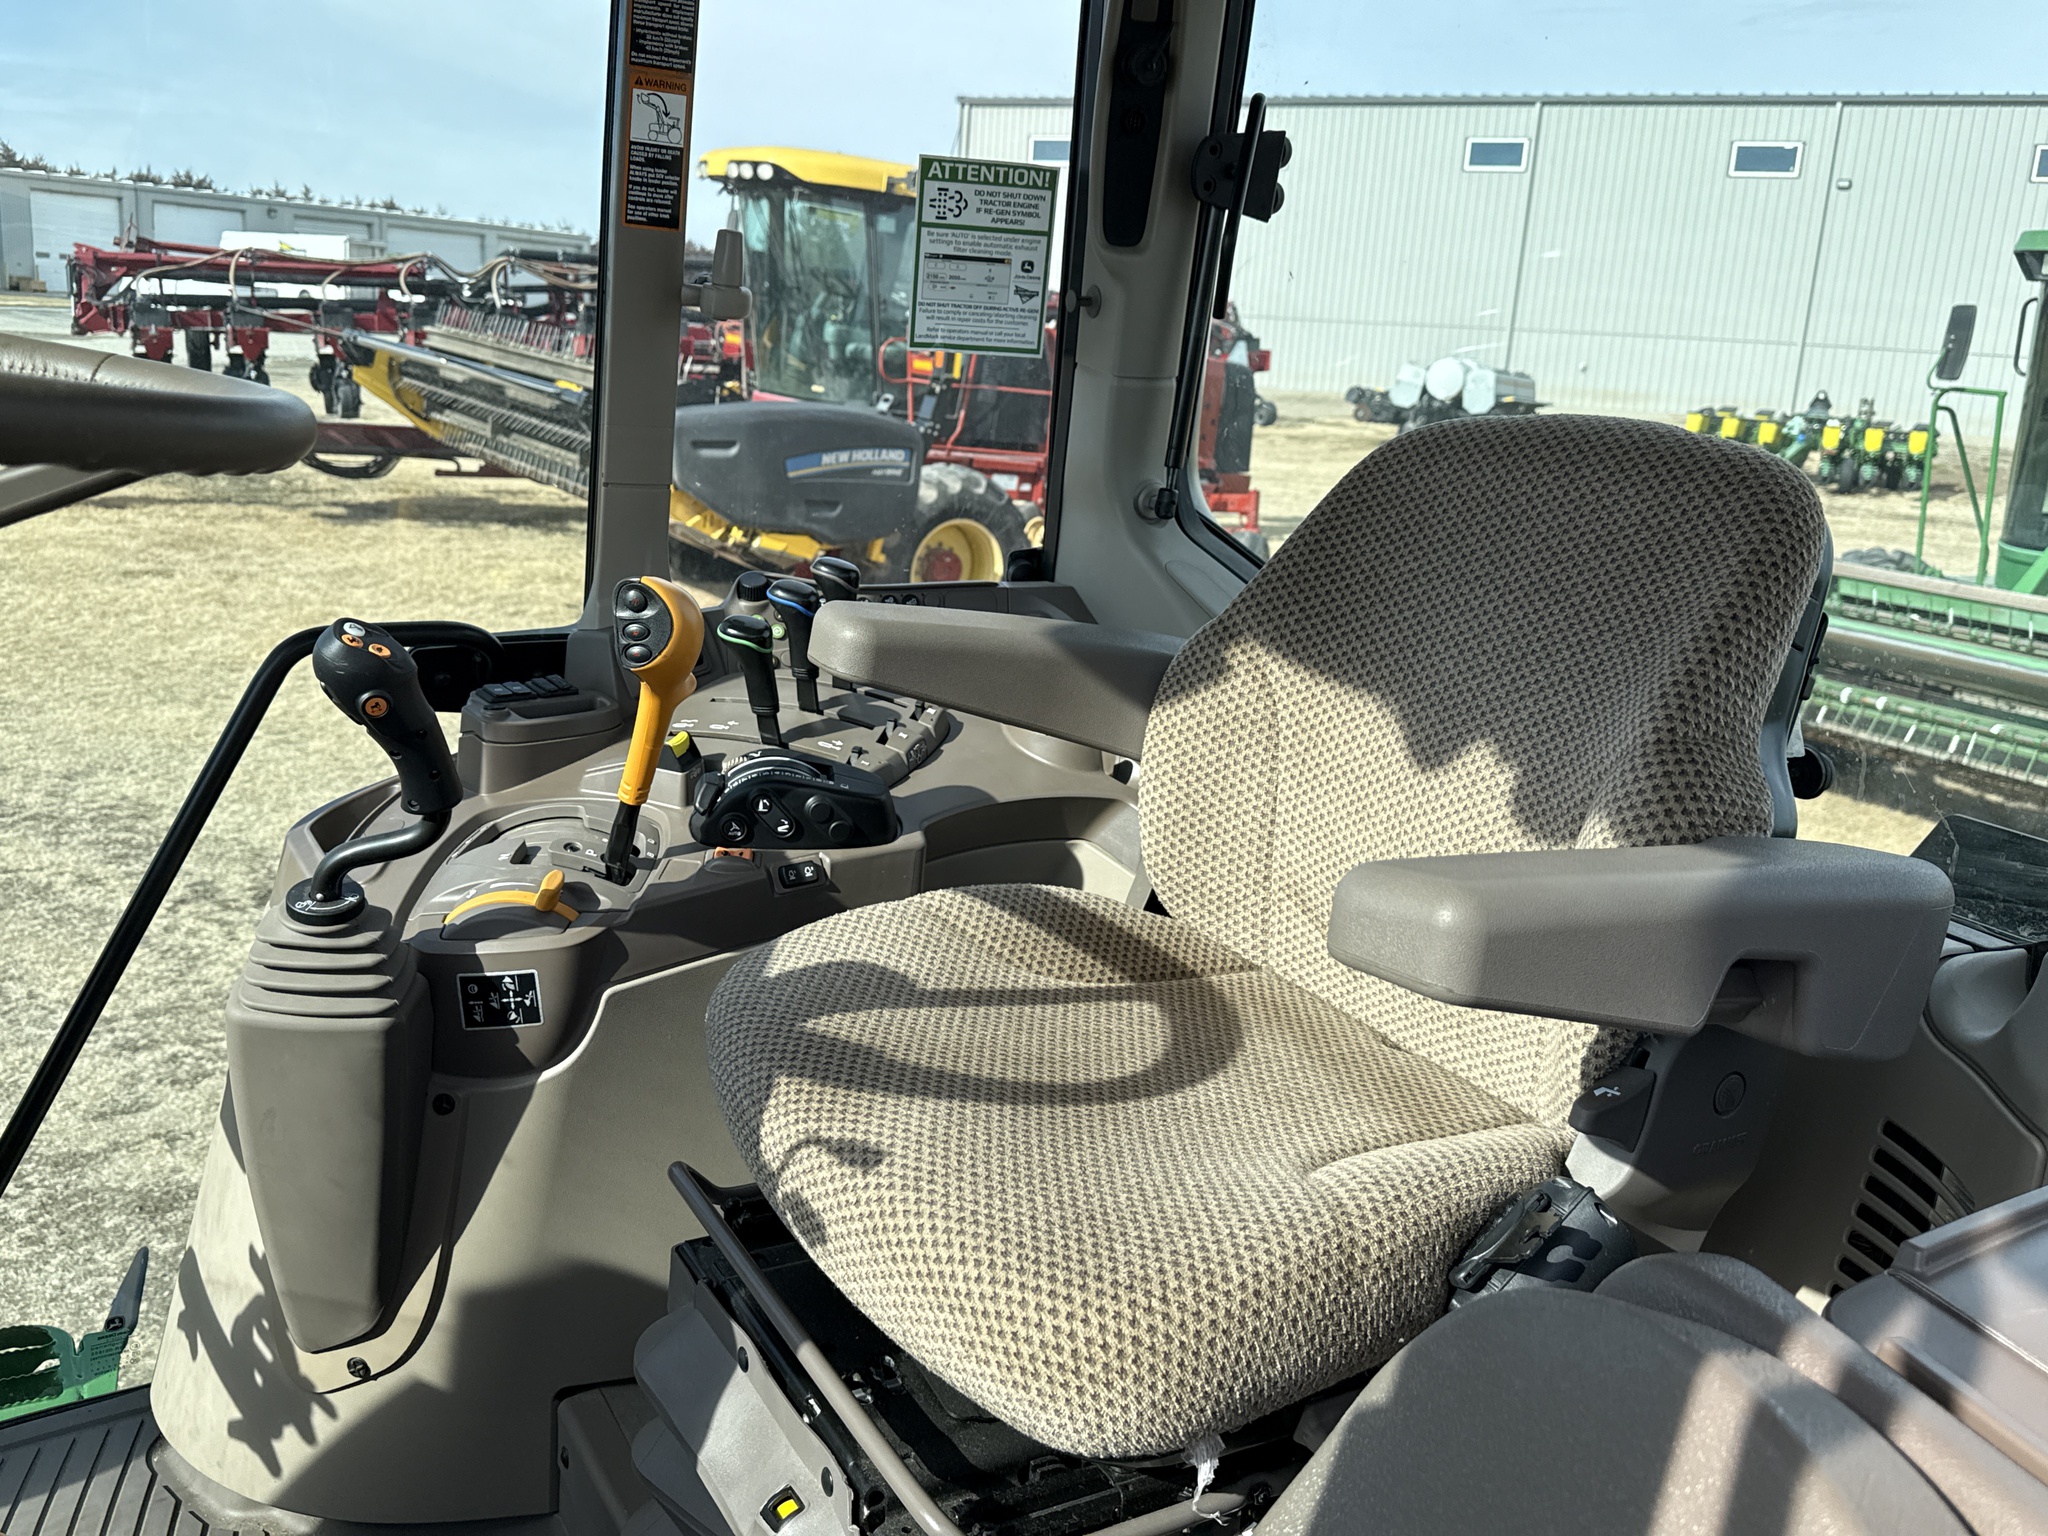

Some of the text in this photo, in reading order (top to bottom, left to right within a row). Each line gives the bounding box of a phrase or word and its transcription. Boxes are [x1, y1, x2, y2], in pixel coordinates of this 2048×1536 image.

[645, 78, 687, 92] WARNING
[928, 160, 1050, 188] ATTENTION!
[974, 189, 1046, 202] DO NOT SHUT DOWN
[980, 199, 1040, 210] TRACTOR ENGINE
[984, 207, 1011, 216] RE-GEN
[1012, 210, 1041, 218] SYMBOL
[991, 217, 1025, 226] APPEARS!
[929, 237, 954, 246] settings
[1021, 238, 1041, 246] engine
[968, 247, 994, 256] cleaning
[821, 449, 906, 465] NEW HOLLAND
